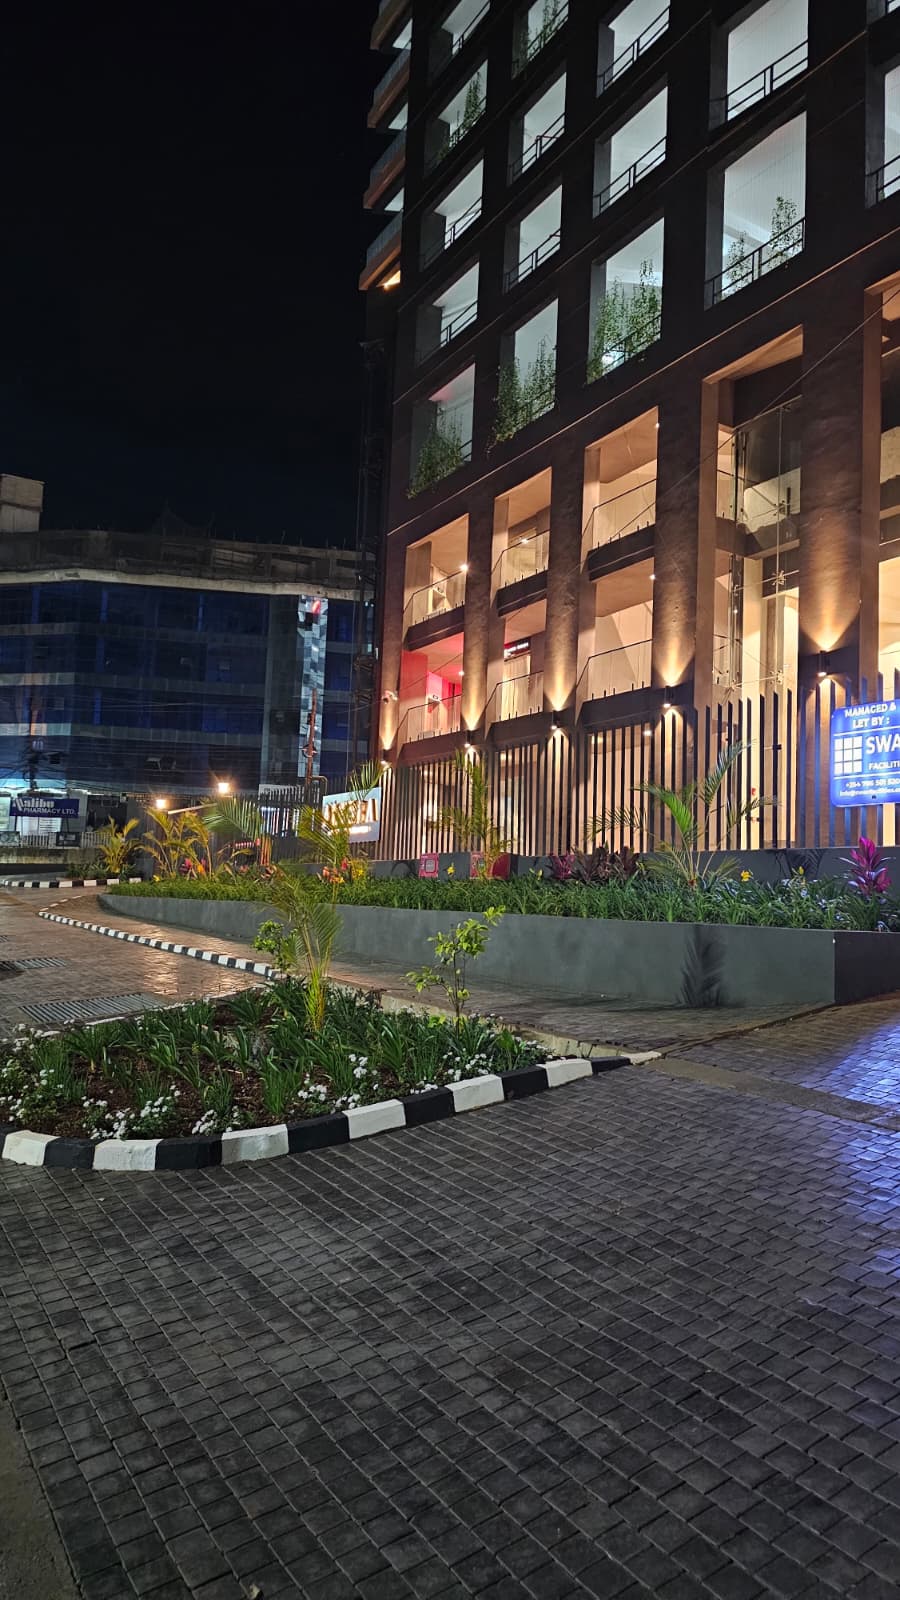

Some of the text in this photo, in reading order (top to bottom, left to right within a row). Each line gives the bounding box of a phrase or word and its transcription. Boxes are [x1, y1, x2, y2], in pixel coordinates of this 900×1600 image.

[845, 703, 888, 718] MANAGED
[853, 718, 869, 728] LET
[871, 716, 885, 726] BY
